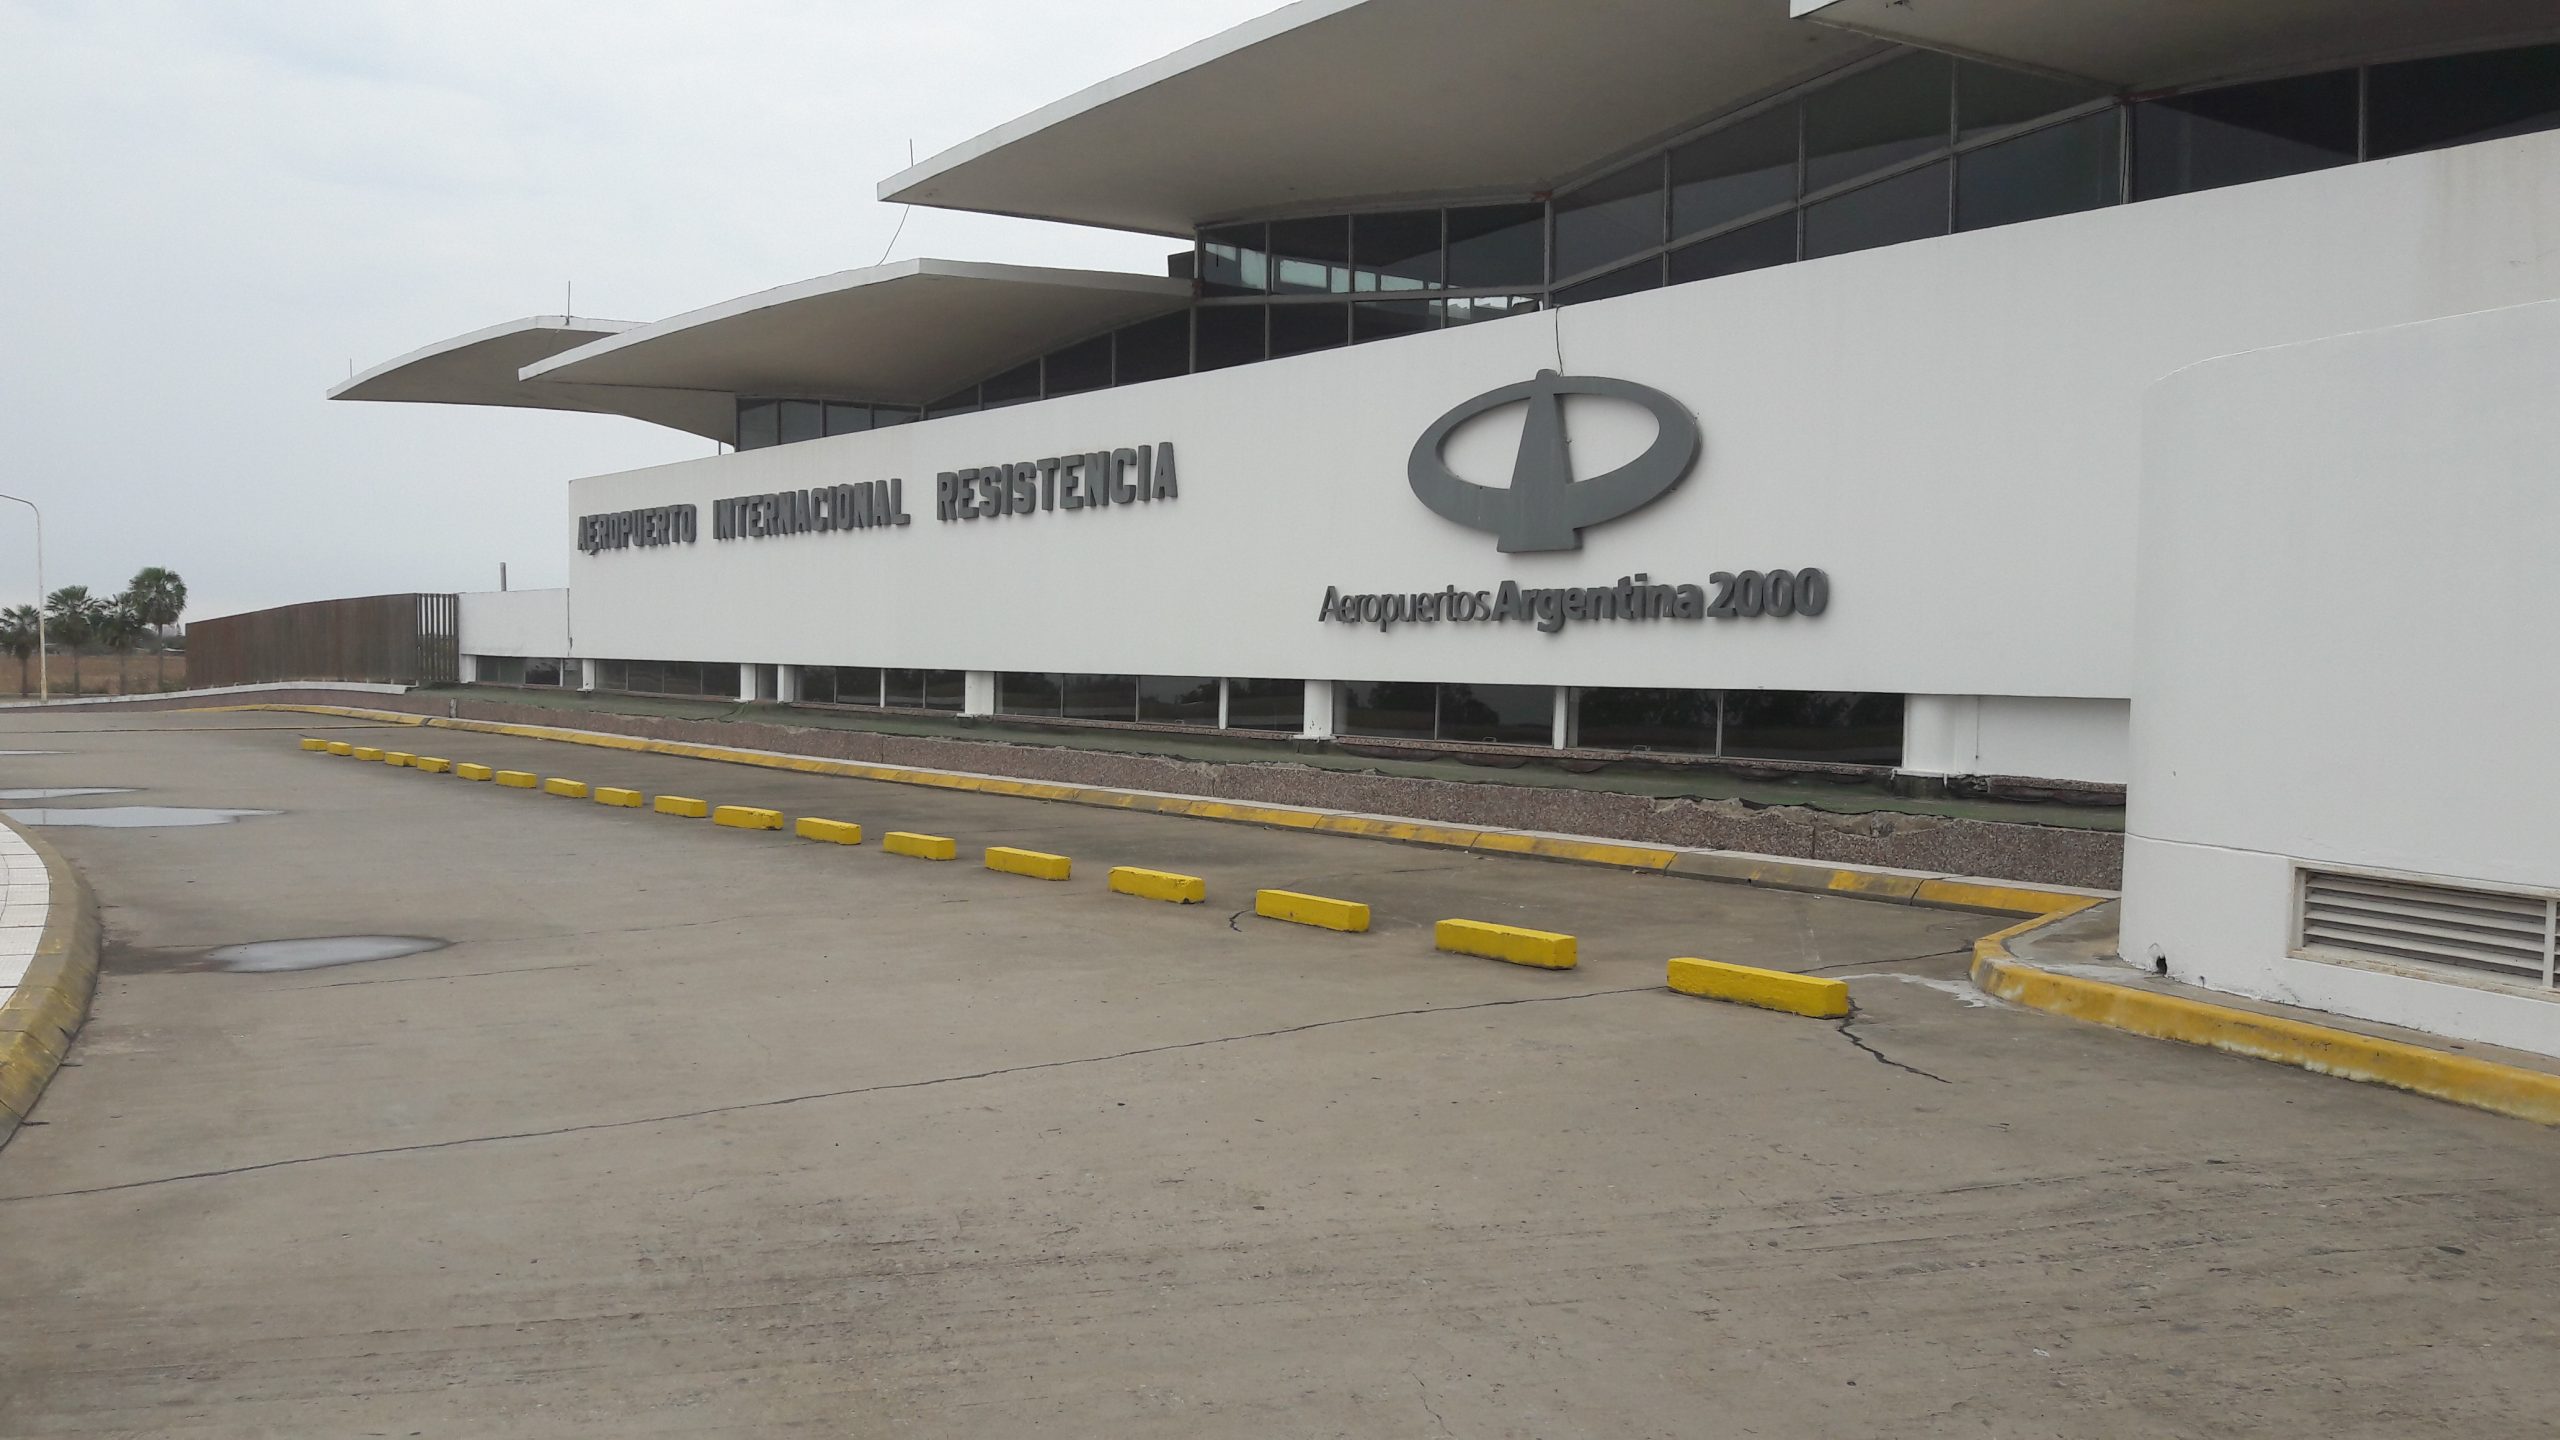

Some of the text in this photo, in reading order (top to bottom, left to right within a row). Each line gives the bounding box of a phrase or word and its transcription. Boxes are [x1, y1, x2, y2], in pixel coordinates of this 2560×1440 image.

[577, 441, 1178, 555] AEROPUERTO INTERNACIONAL RESISTENCIA
[1319, 567, 1829, 634] Aeropuertos Argentina 2000
